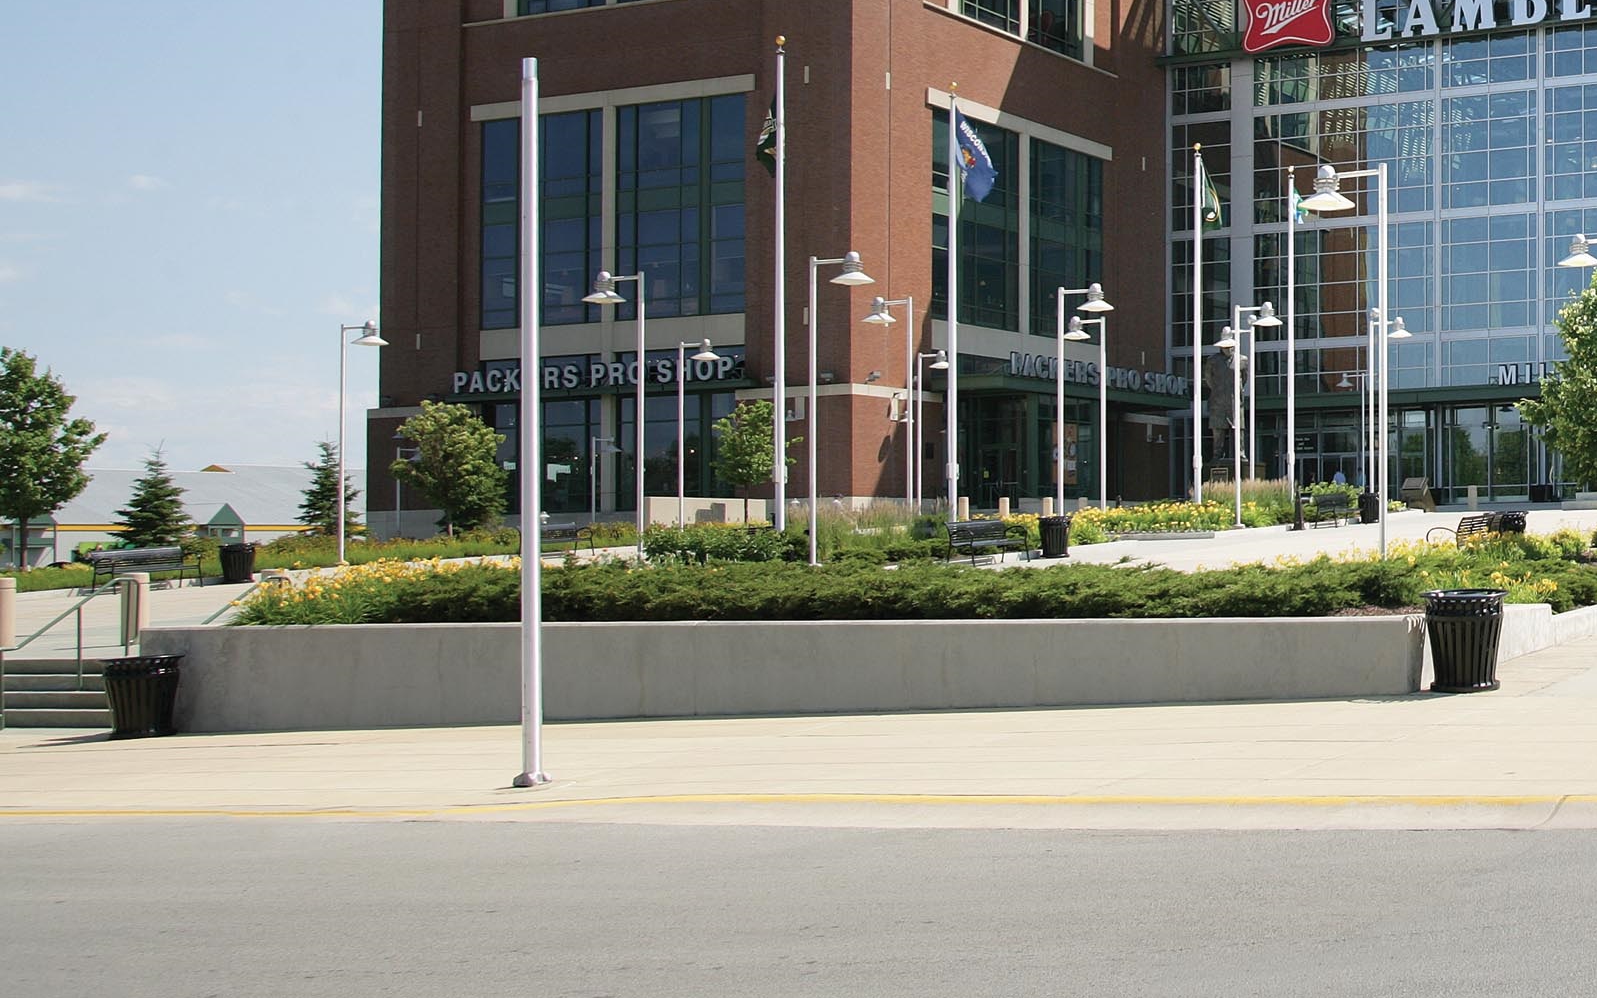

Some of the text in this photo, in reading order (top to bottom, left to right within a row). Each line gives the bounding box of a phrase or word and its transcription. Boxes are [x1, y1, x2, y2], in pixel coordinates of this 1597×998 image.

[453, 355, 735, 394] PACKRS PRO SHOP
[1106, 366, 1142, 390] PRO
[1144, 371, 1188, 396] SHOP
